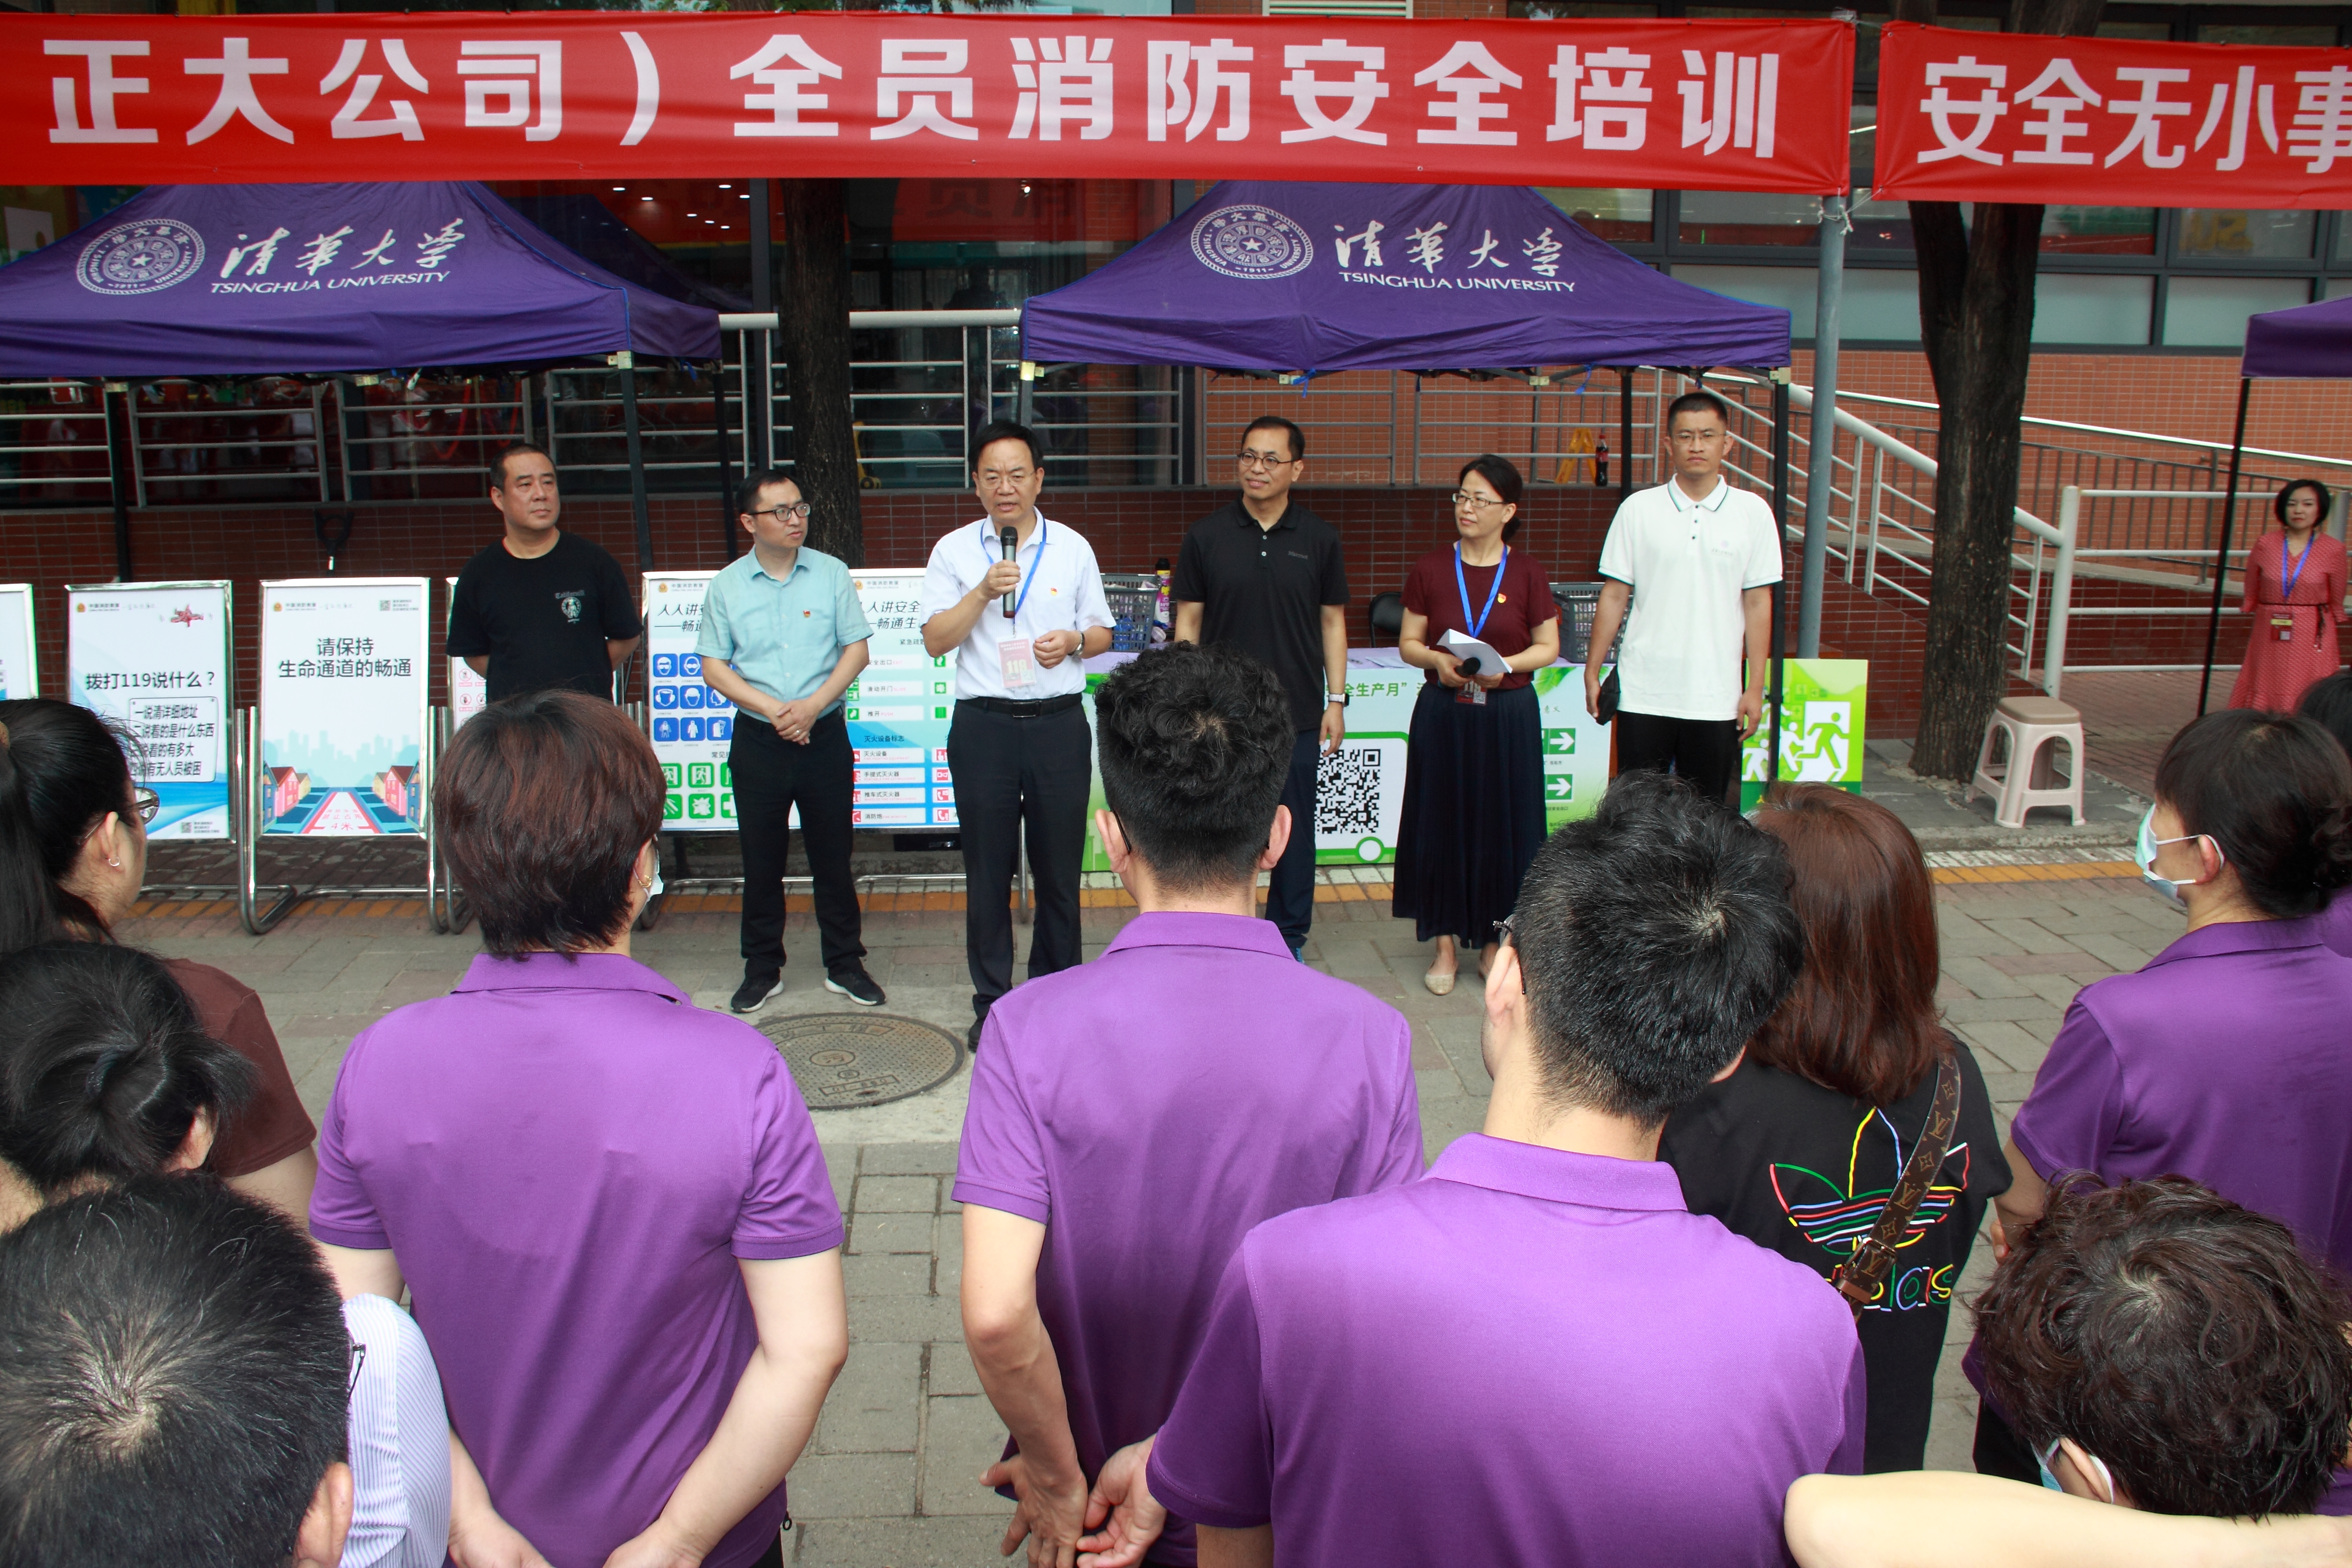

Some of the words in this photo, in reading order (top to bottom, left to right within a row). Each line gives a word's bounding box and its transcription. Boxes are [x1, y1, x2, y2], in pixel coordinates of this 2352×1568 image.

[1917, 55, 2352, 173] 安全无小事
[211, 280, 321, 293] TSINGHUA
[327, 271, 451, 289] UNIVERSITY
[1338, 272, 1453, 290] TSINGHUA
[1457, 278, 1575, 292] UNIVERSITY
[861, 600, 921, 613] 人讲安全
[317, 637, 374, 656] 请保持
[279, 658, 412, 678] 生命通道的畅通
[86, 671, 215, 690] 拨打119说什么？
[331, 822, 353, 831] 4米
